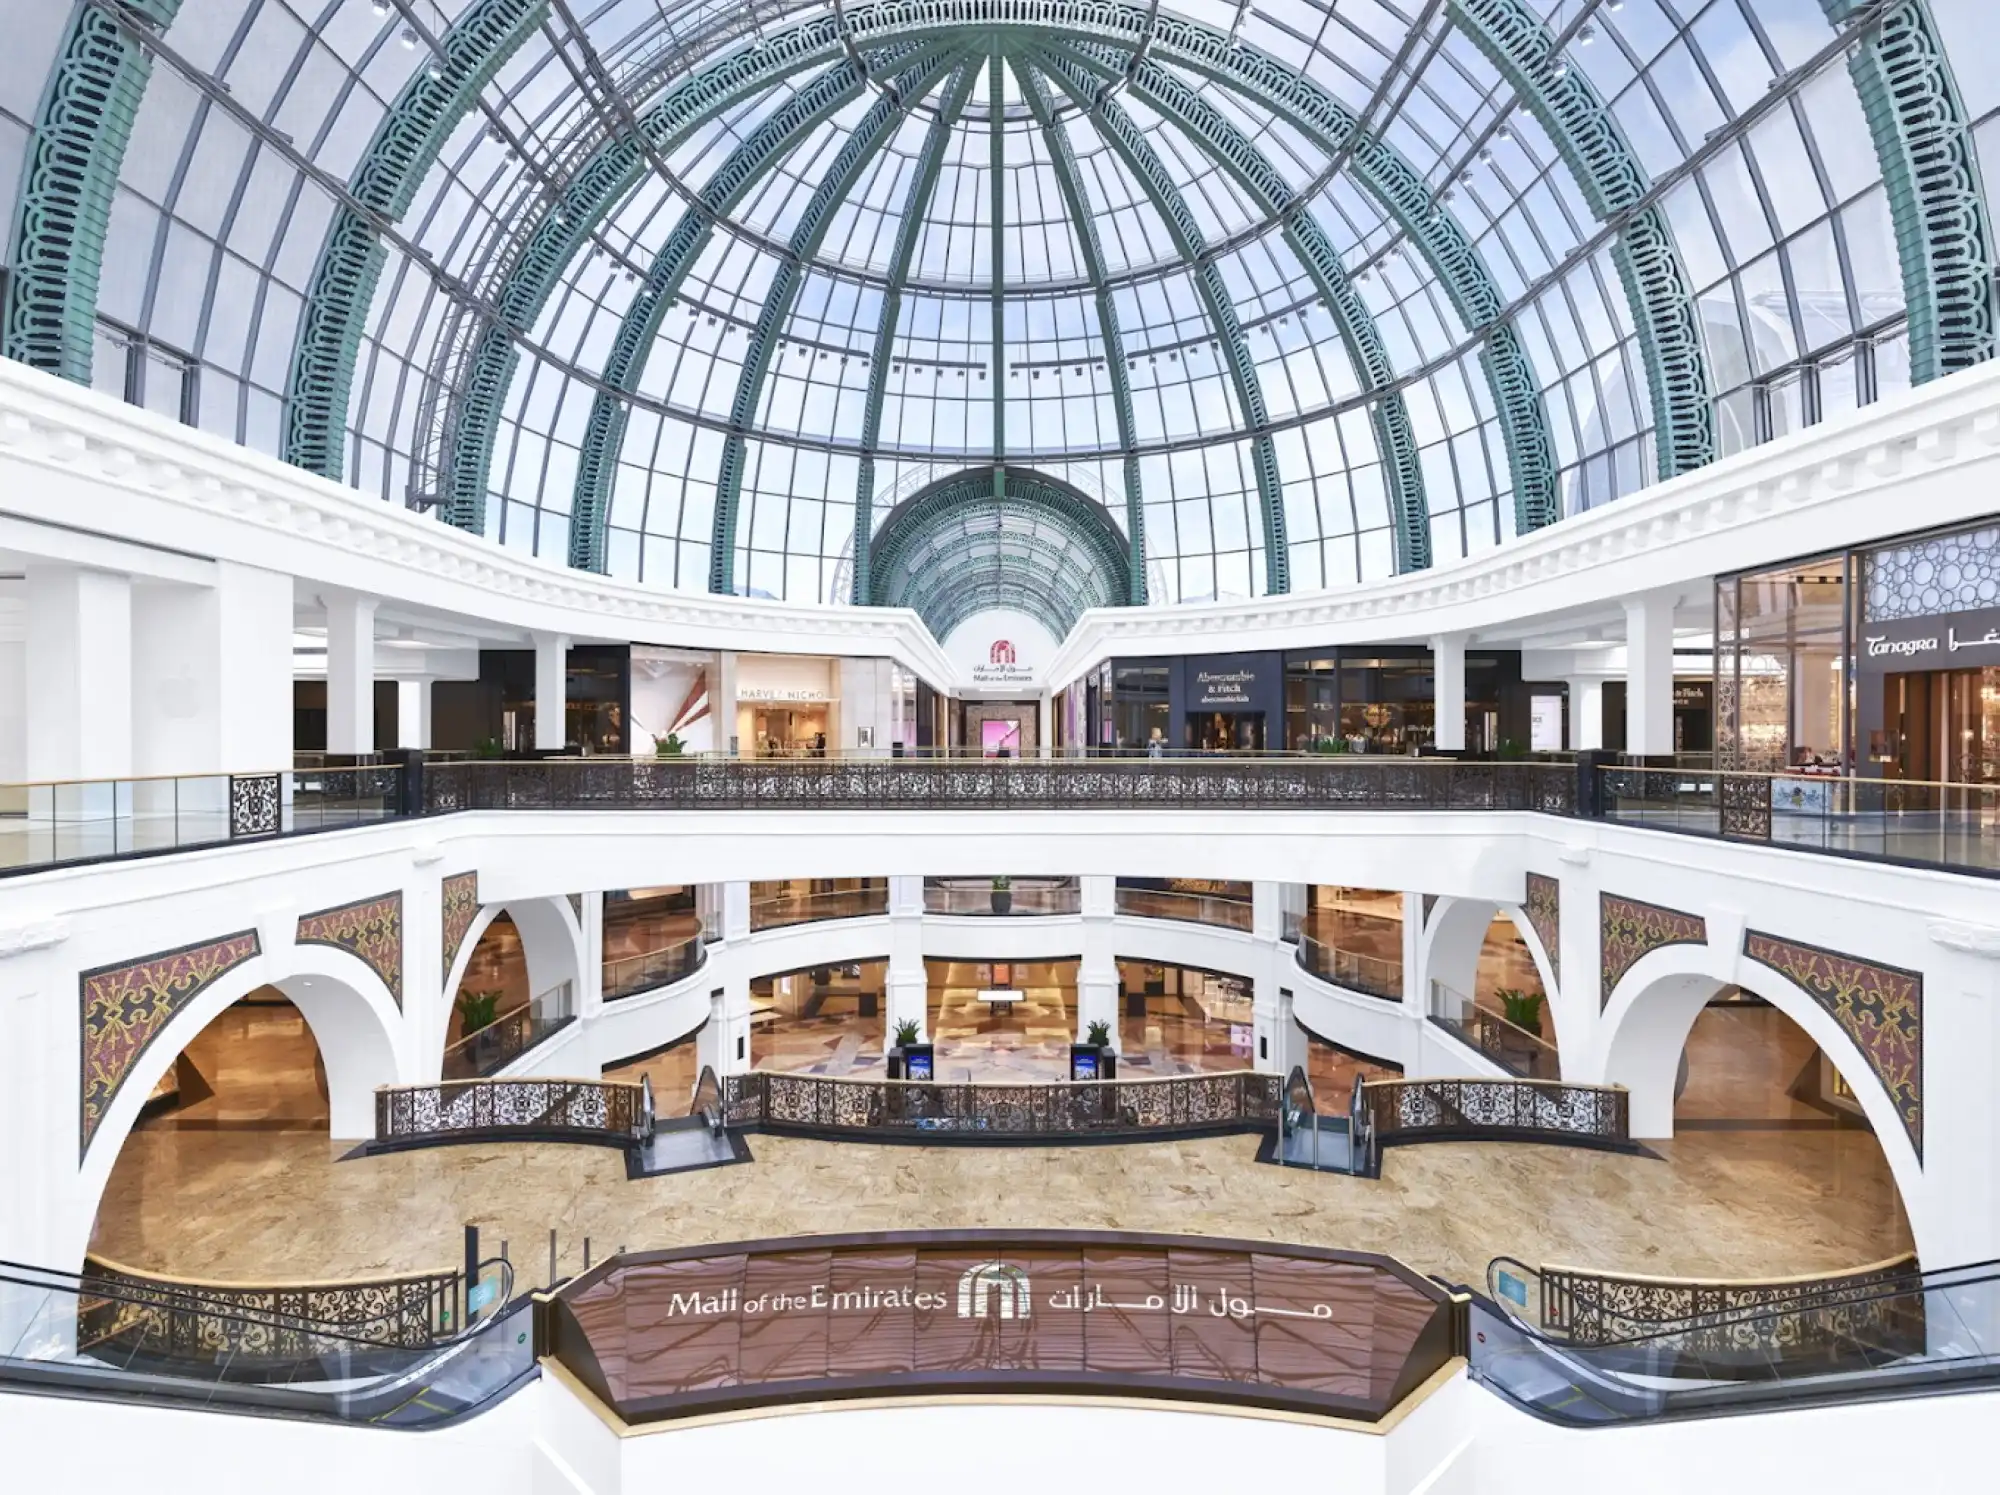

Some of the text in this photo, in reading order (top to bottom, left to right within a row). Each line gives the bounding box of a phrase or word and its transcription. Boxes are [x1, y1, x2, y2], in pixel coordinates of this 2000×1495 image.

[1865, 635, 1938, 657] Tanagra
[1218, 684, 1241, 693] Fitch
[667, 1284, 947, 1317] Mall of the Emirates
